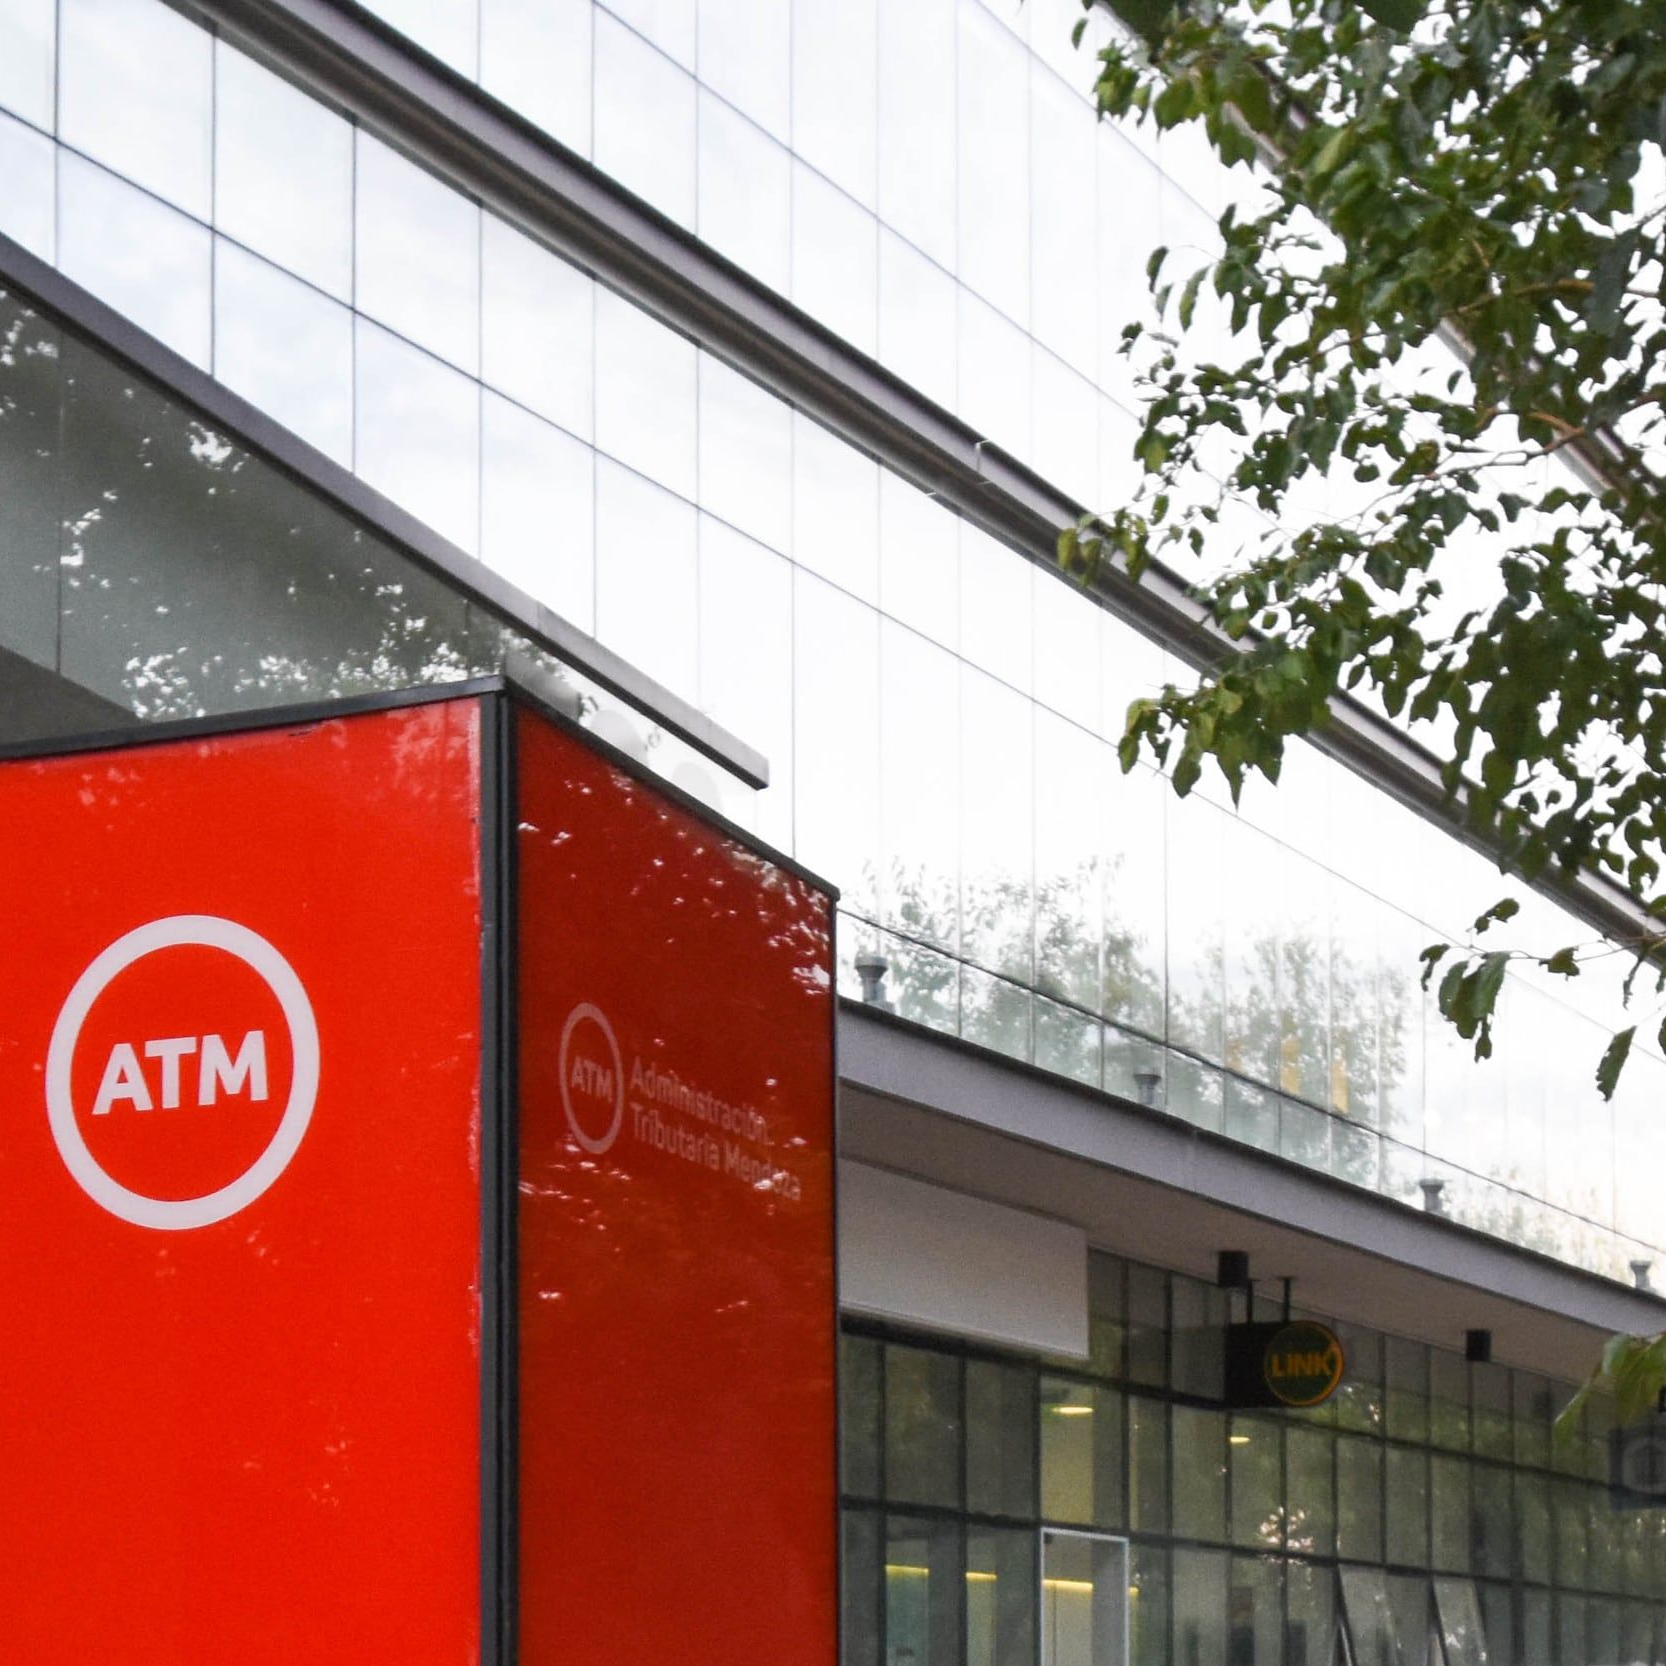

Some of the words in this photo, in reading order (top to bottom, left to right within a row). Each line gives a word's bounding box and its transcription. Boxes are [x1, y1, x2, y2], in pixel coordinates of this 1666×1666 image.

[92, 1029, 269, 1115] ATM
[571, 1056, 614, 1103] ATM
[631, 1055, 769, 1145] Administración
[631, 1101, 721, 1172] Tributaria
[1271, 1351, 1332, 1378] LINK
